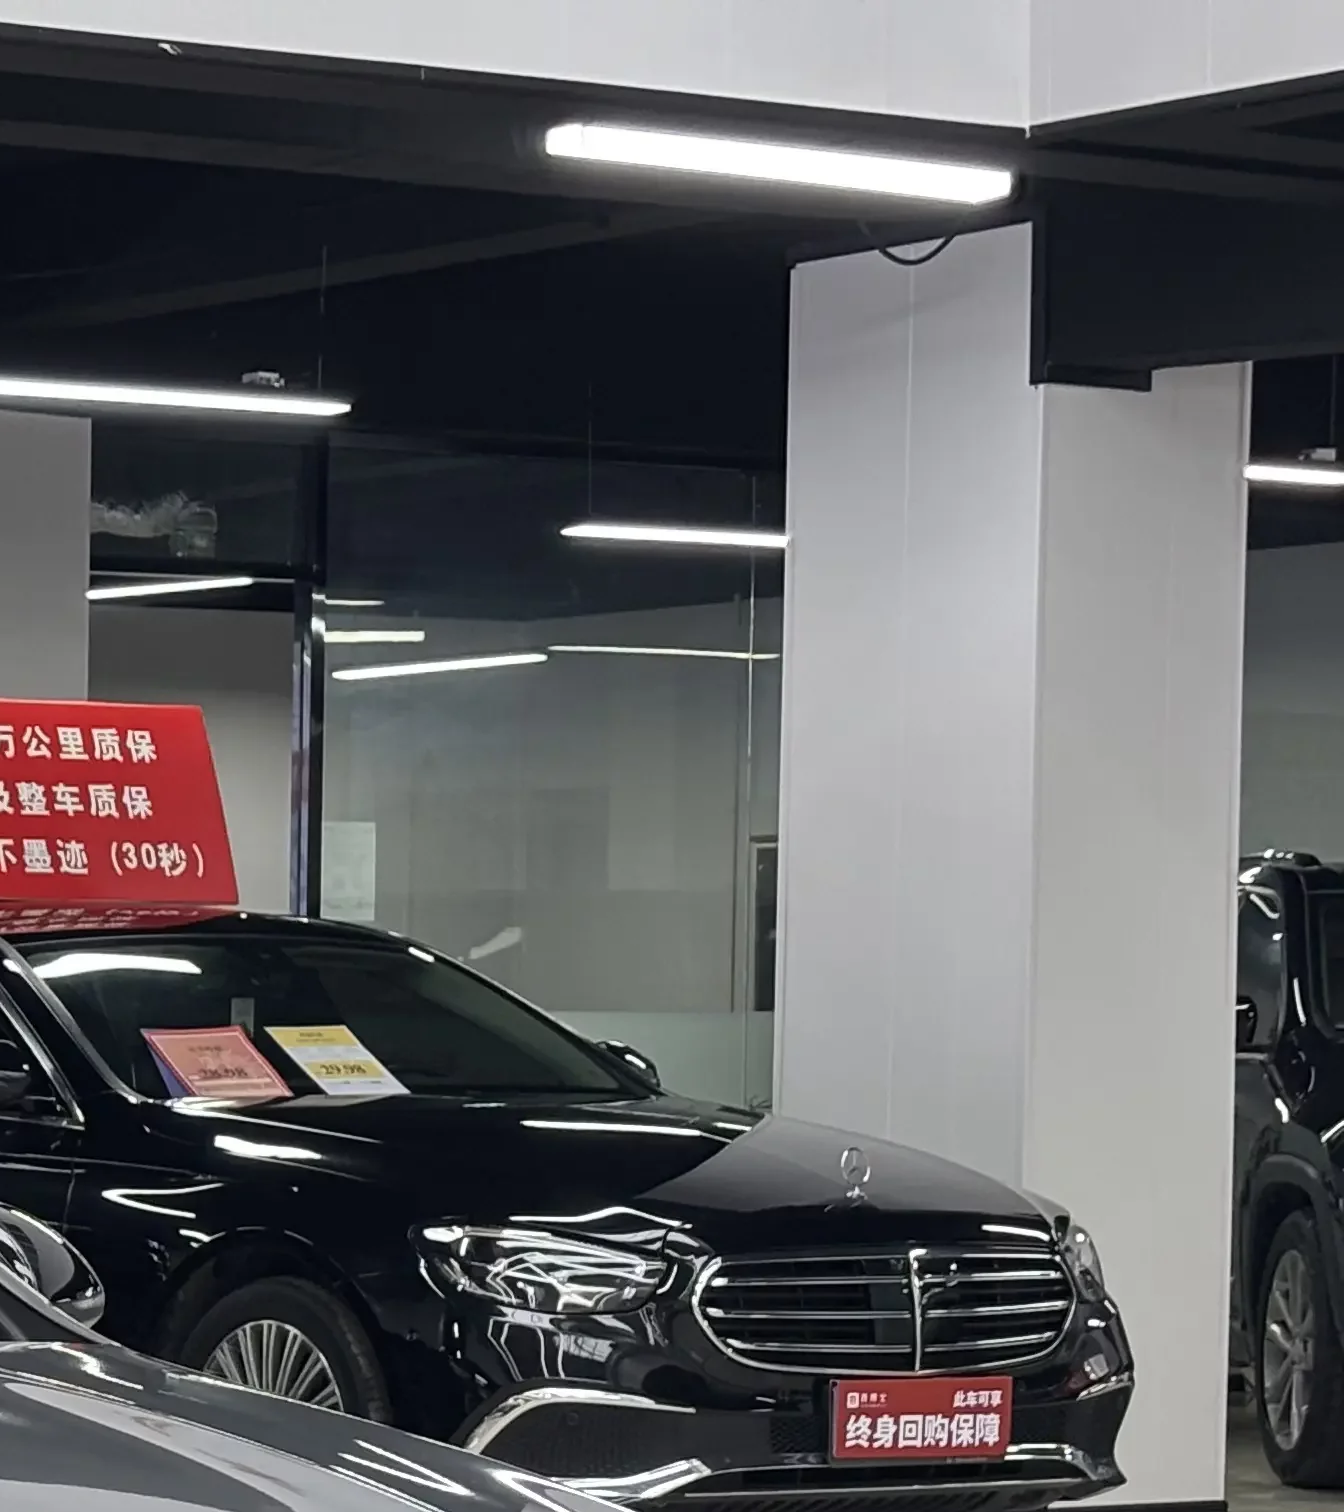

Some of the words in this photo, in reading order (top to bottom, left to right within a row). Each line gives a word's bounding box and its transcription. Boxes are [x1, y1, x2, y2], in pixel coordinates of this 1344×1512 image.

[952, 1389, 1003, 1409] 此车可享
[844, 1412, 1001, 1449] 终身回购保障
